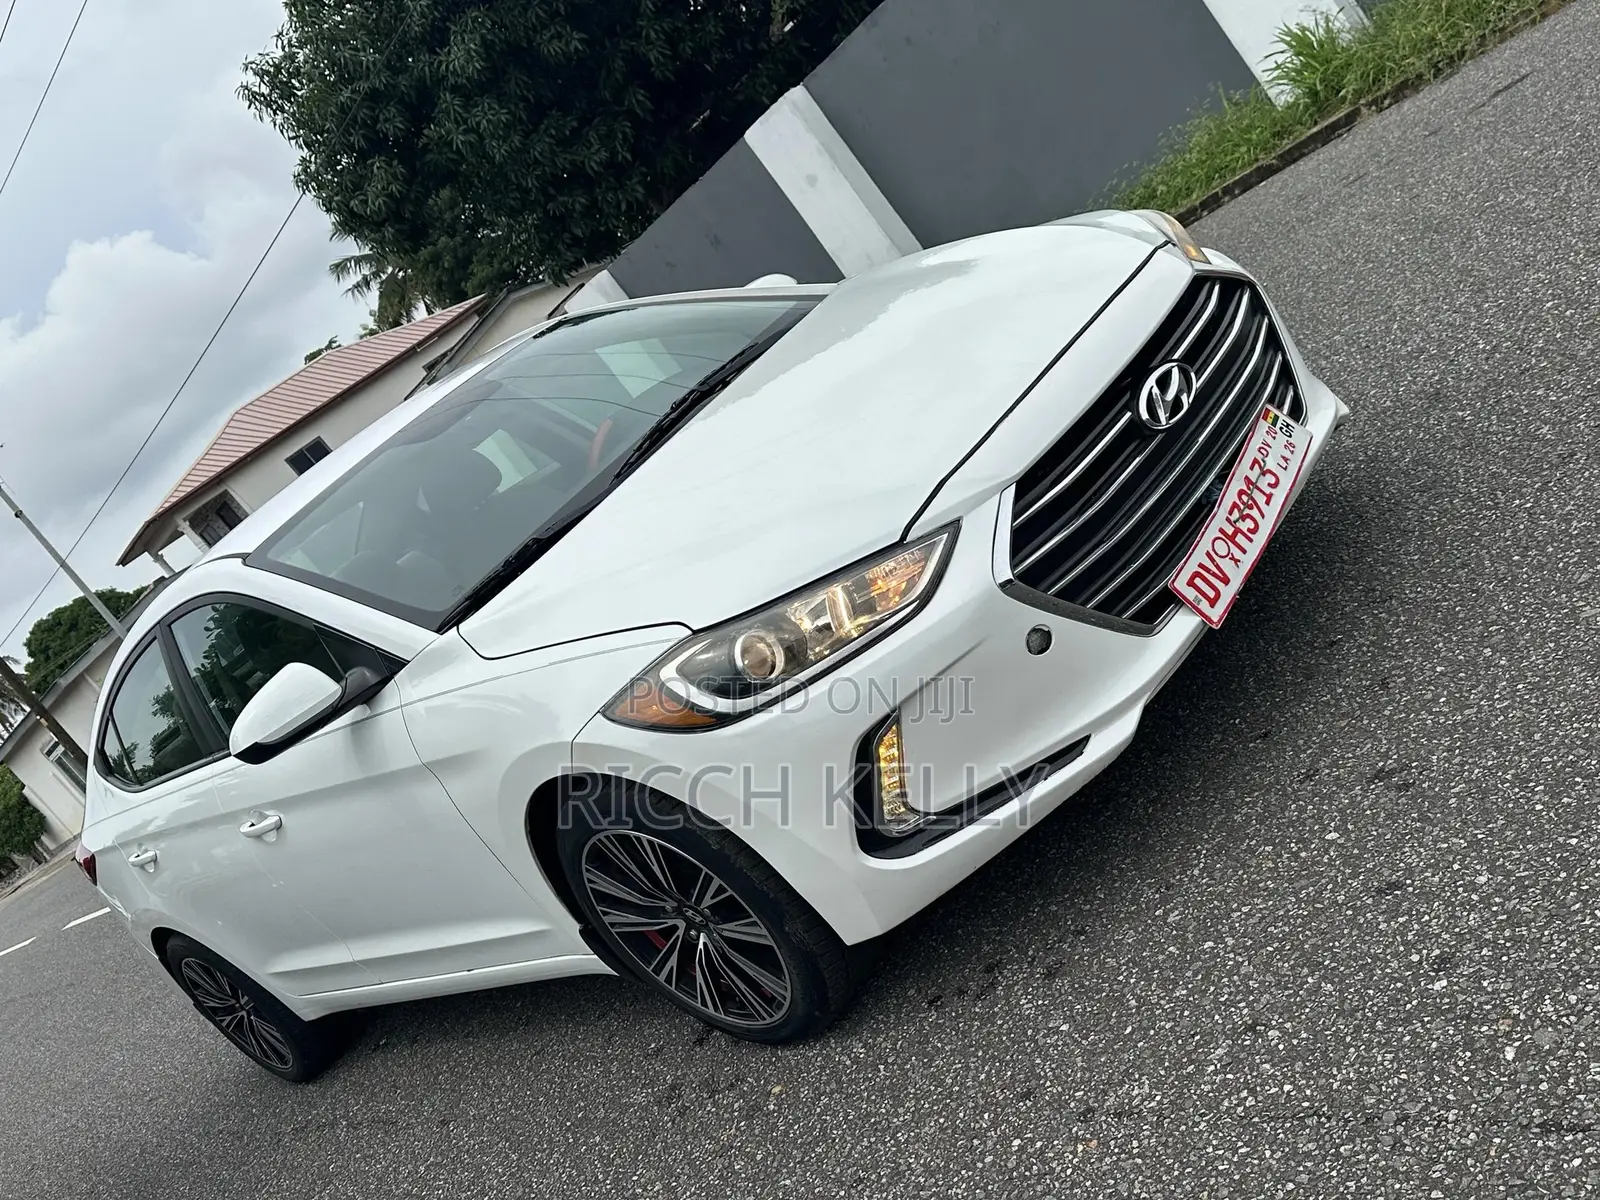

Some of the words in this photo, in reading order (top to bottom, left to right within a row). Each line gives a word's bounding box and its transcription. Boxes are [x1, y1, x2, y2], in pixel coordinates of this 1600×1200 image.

[1257, 436, 1273, 458] DV
[1266, 425, 1278, 441] 20
[1280, 419, 1295, 439] GH
[1277, 455, 1291, 471] LA
[1284, 440, 1296, 454] 26
[1186, 550, 1231, 609] DV
